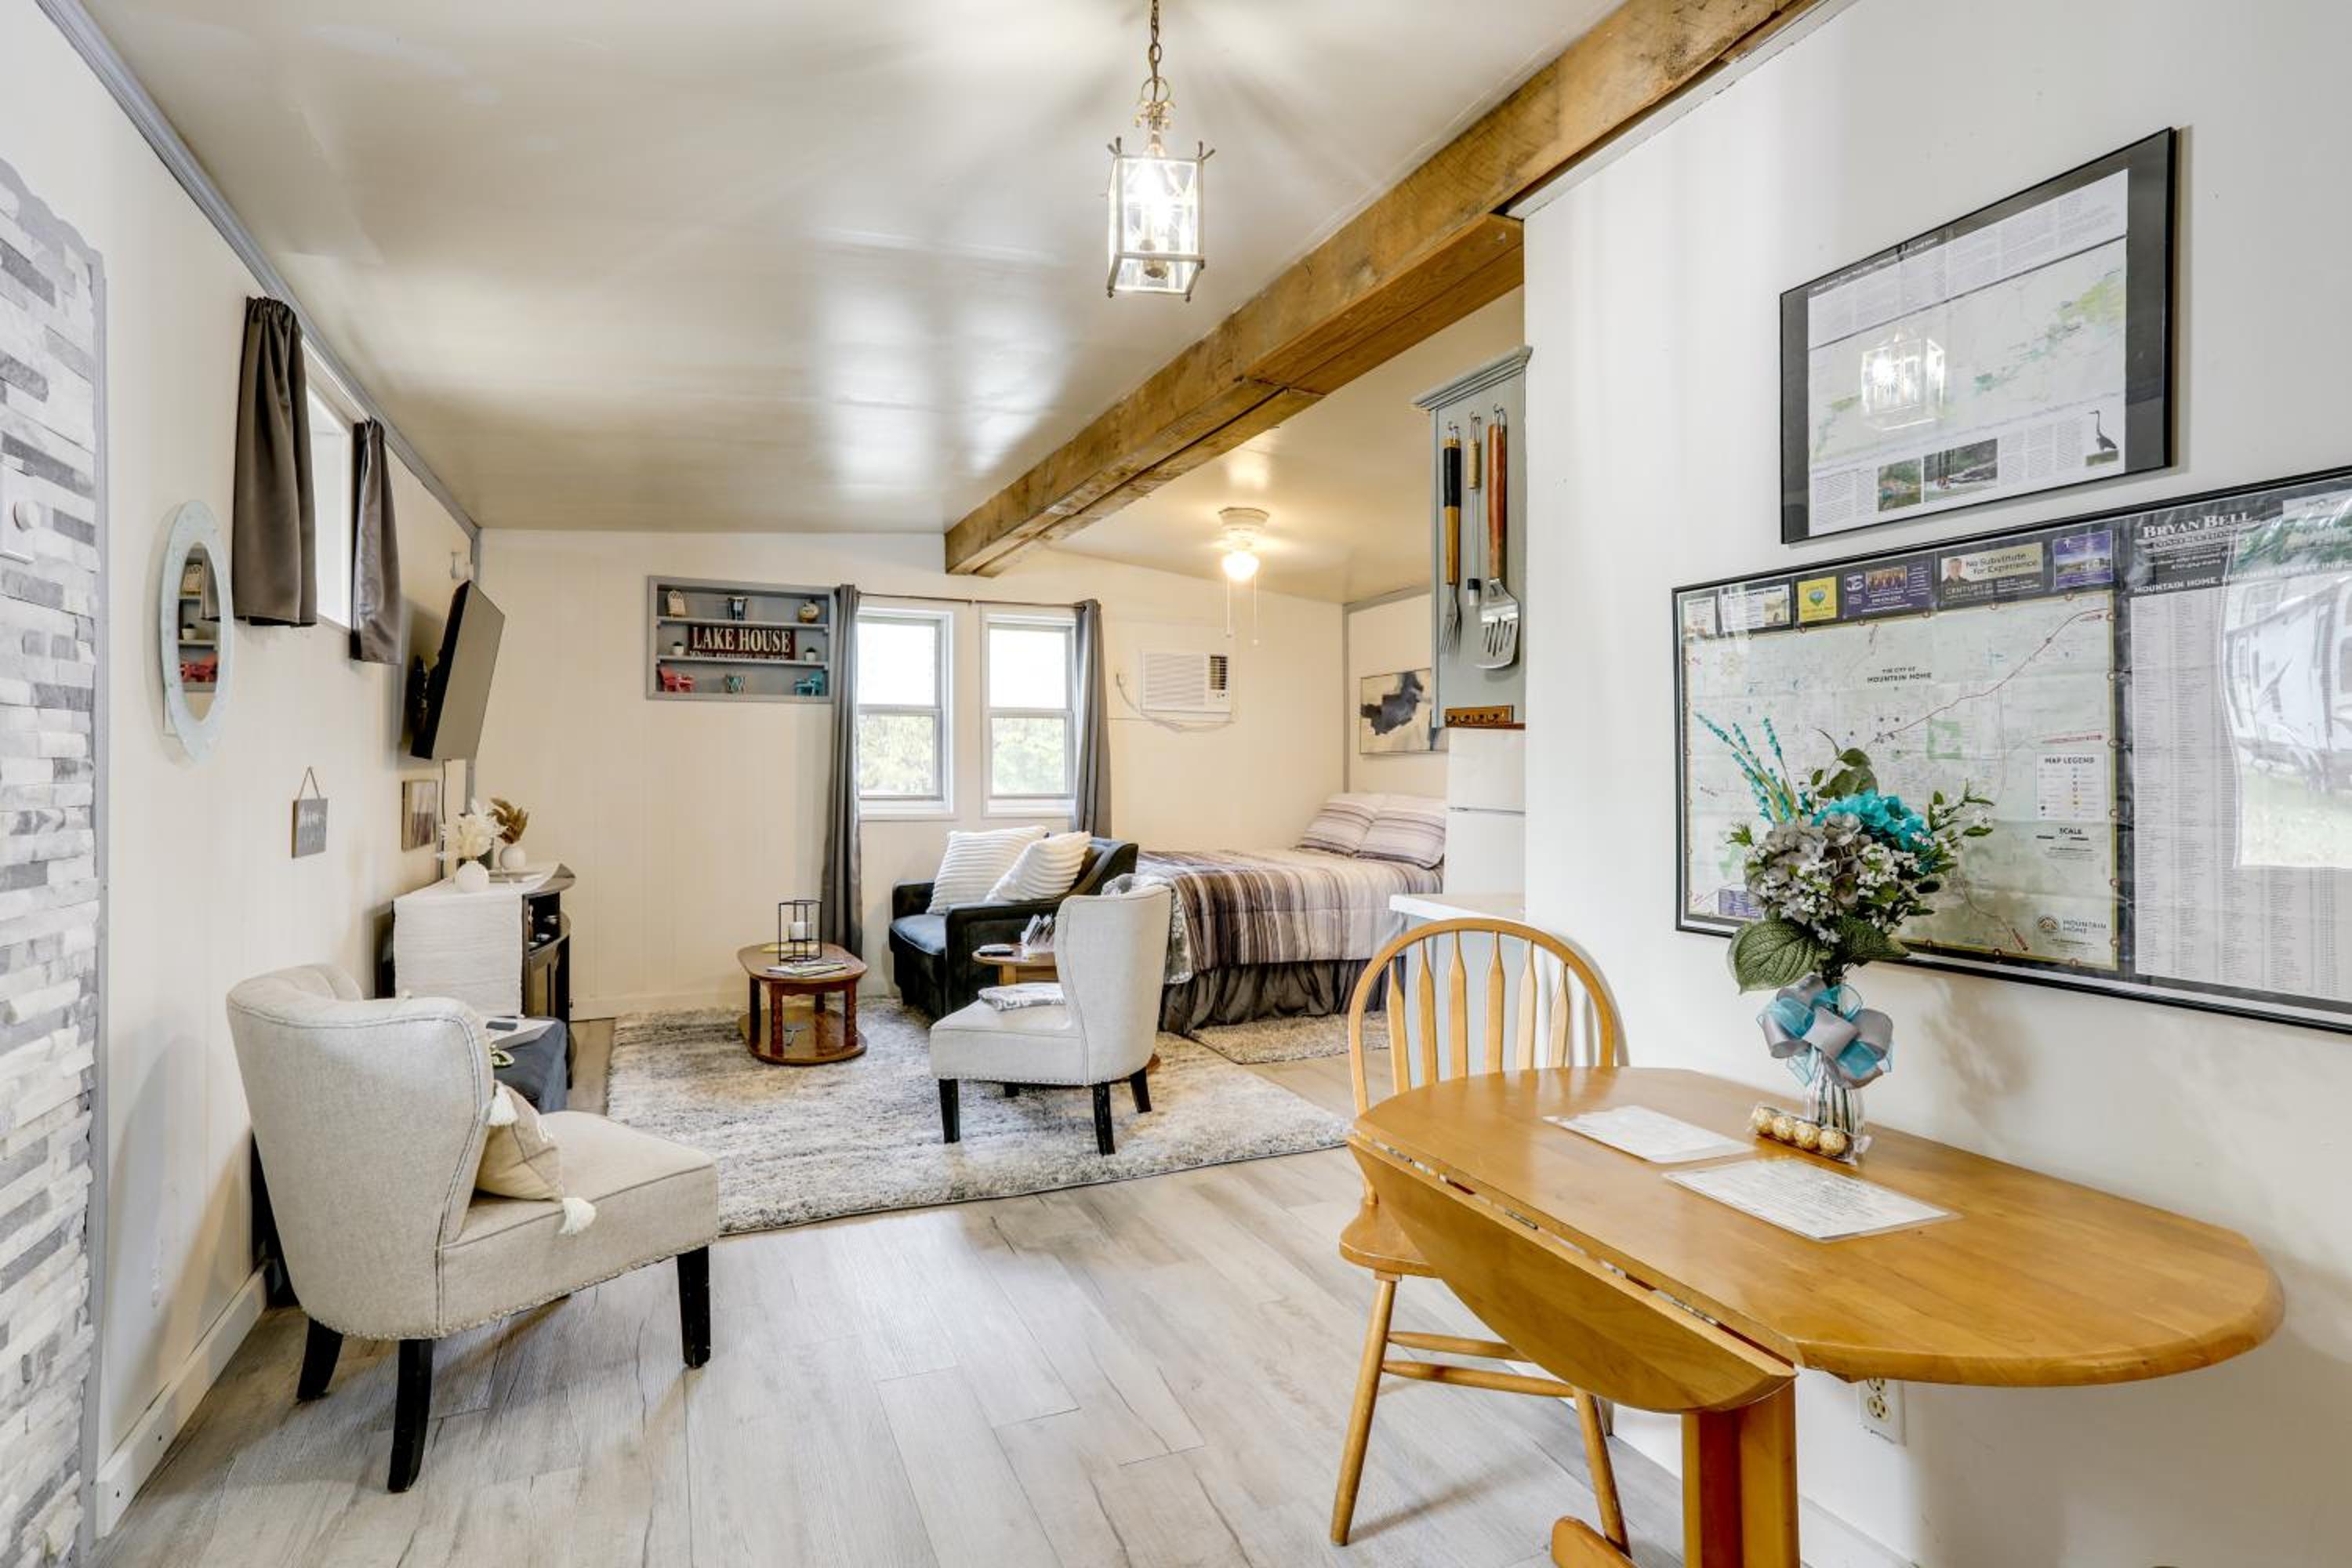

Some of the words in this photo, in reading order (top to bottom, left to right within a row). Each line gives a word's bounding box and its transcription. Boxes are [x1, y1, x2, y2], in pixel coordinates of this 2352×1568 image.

[2143, 520, 2199, 539] BRYAN
[2204, 511, 2252, 528] BELL
[1980, 553, 2027, 567] Substitute
[1987, 558, 2038, 574] Experience
[2133, 582, 2185, 593] MOUNTAIN
[693, 626, 735, 650] LAKE
[738, 628, 791, 653] HOUSE
[1867, 674, 1907, 683] MOUNTAIN
[2063, 920, 2107, 930] MOUNTAIN
